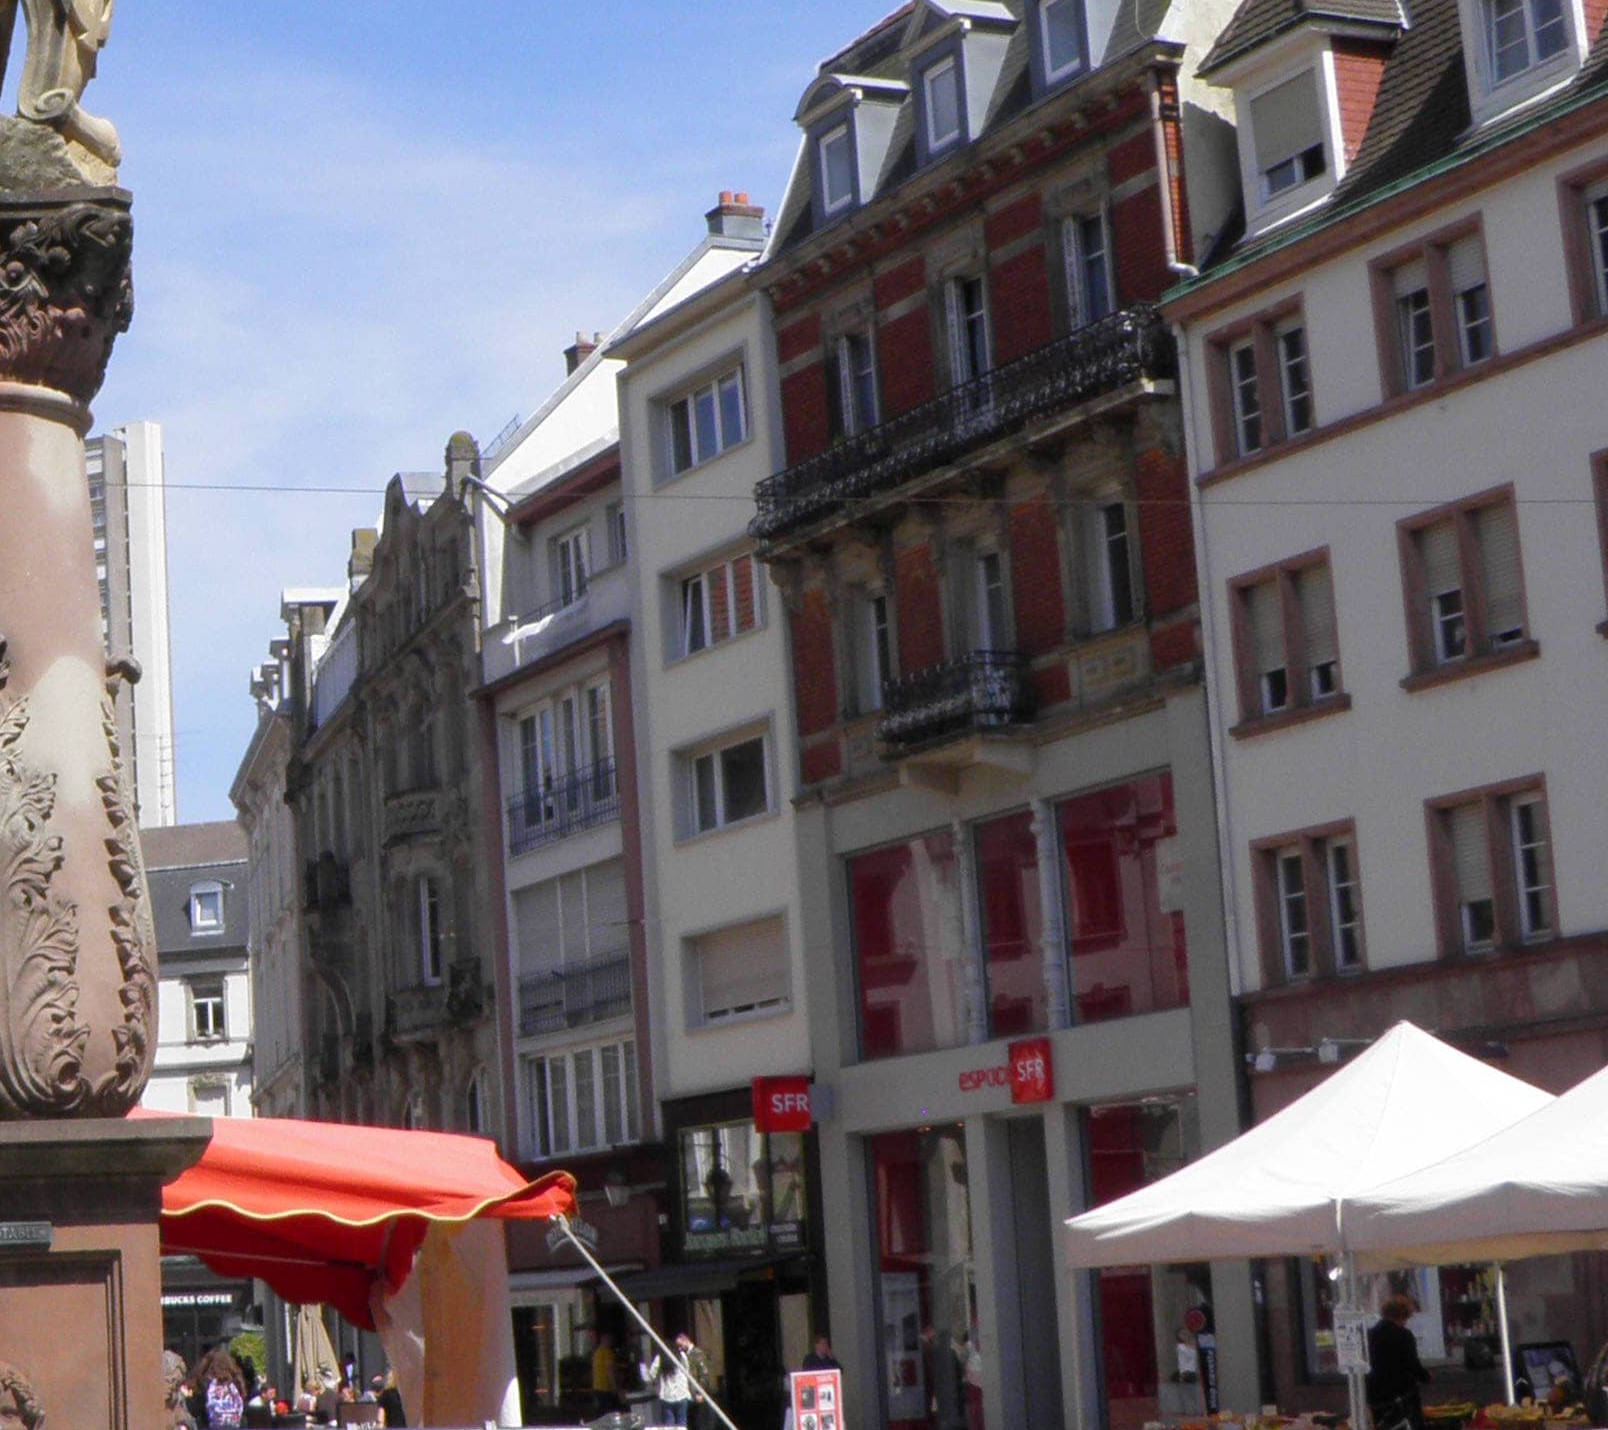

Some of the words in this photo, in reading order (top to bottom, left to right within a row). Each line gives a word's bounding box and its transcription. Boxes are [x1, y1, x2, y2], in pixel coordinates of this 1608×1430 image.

[1016, 1057, 1045, 1083] SFR
[771, 1093, 809, 1115] SFR
[196, 1294, 233, 1304] COFFEE
